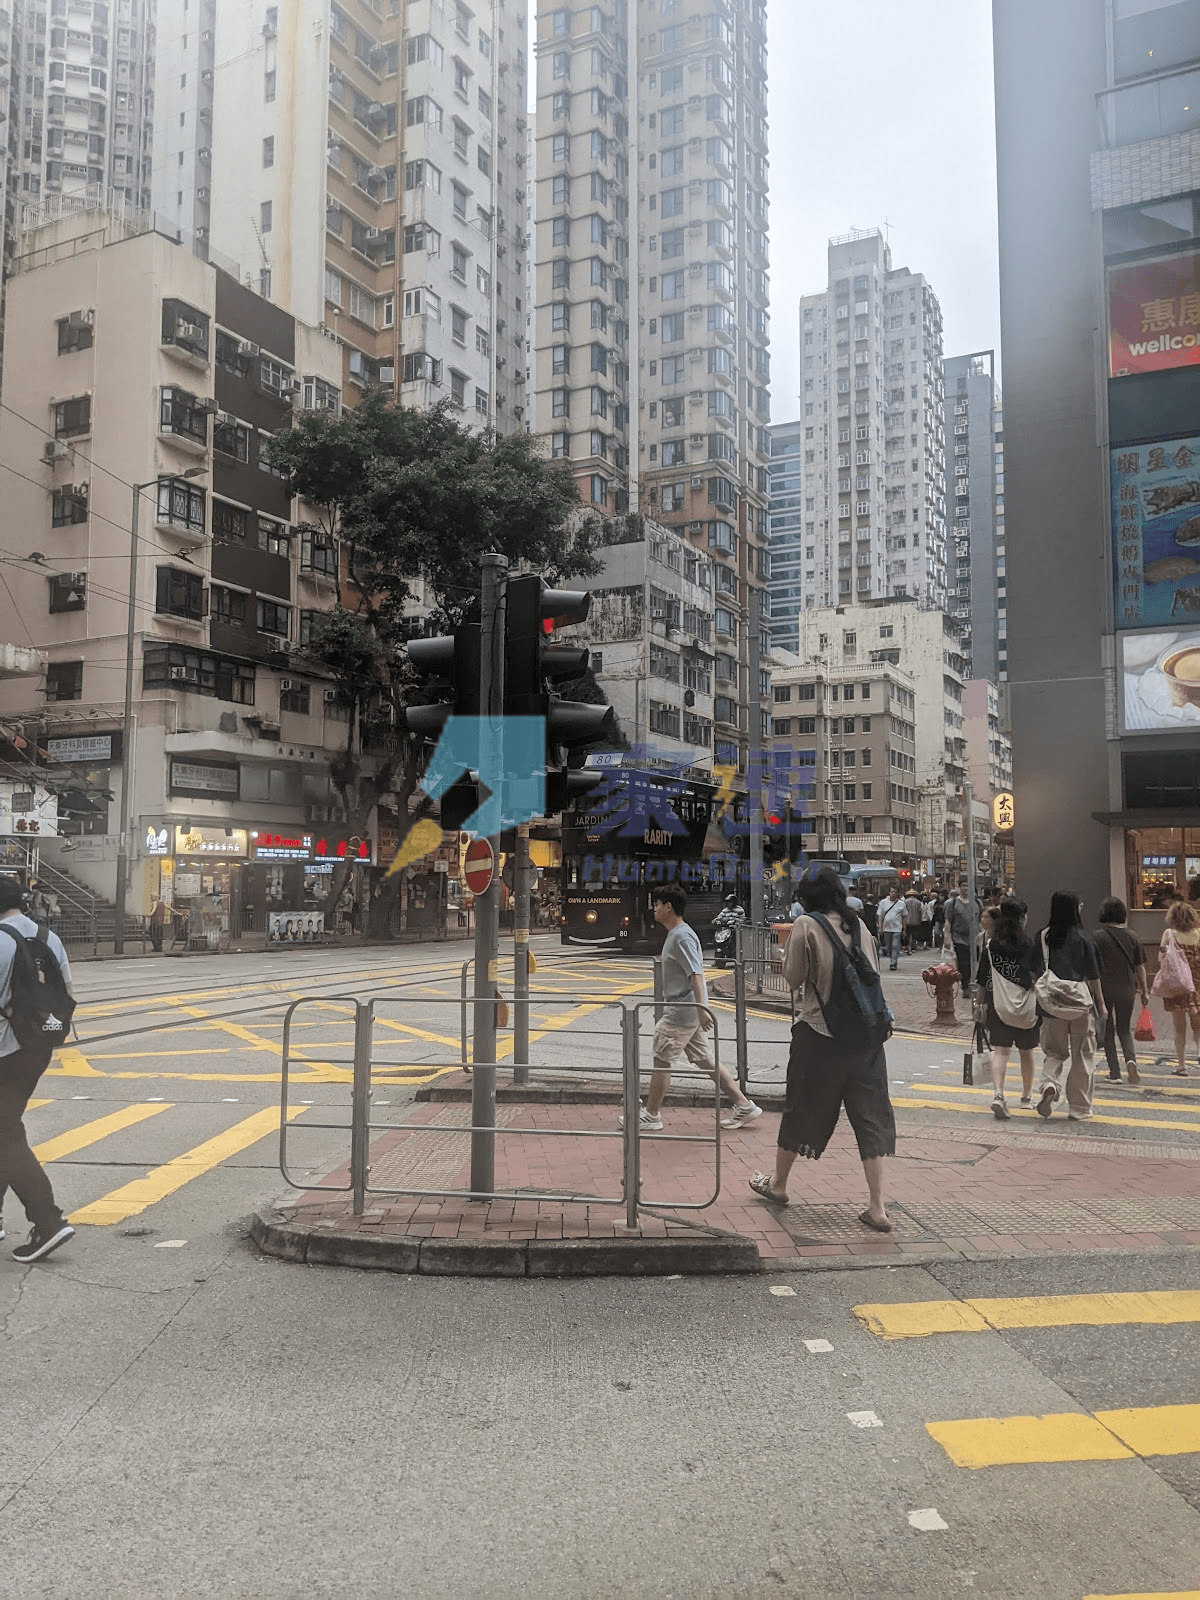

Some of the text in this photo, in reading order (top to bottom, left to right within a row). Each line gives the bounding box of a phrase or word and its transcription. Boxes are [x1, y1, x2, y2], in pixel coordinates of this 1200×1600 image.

[596, 754, 612, 764] 80
[621, 771, 630, 779] 80
[644, 828, 674, 846] RARITY
